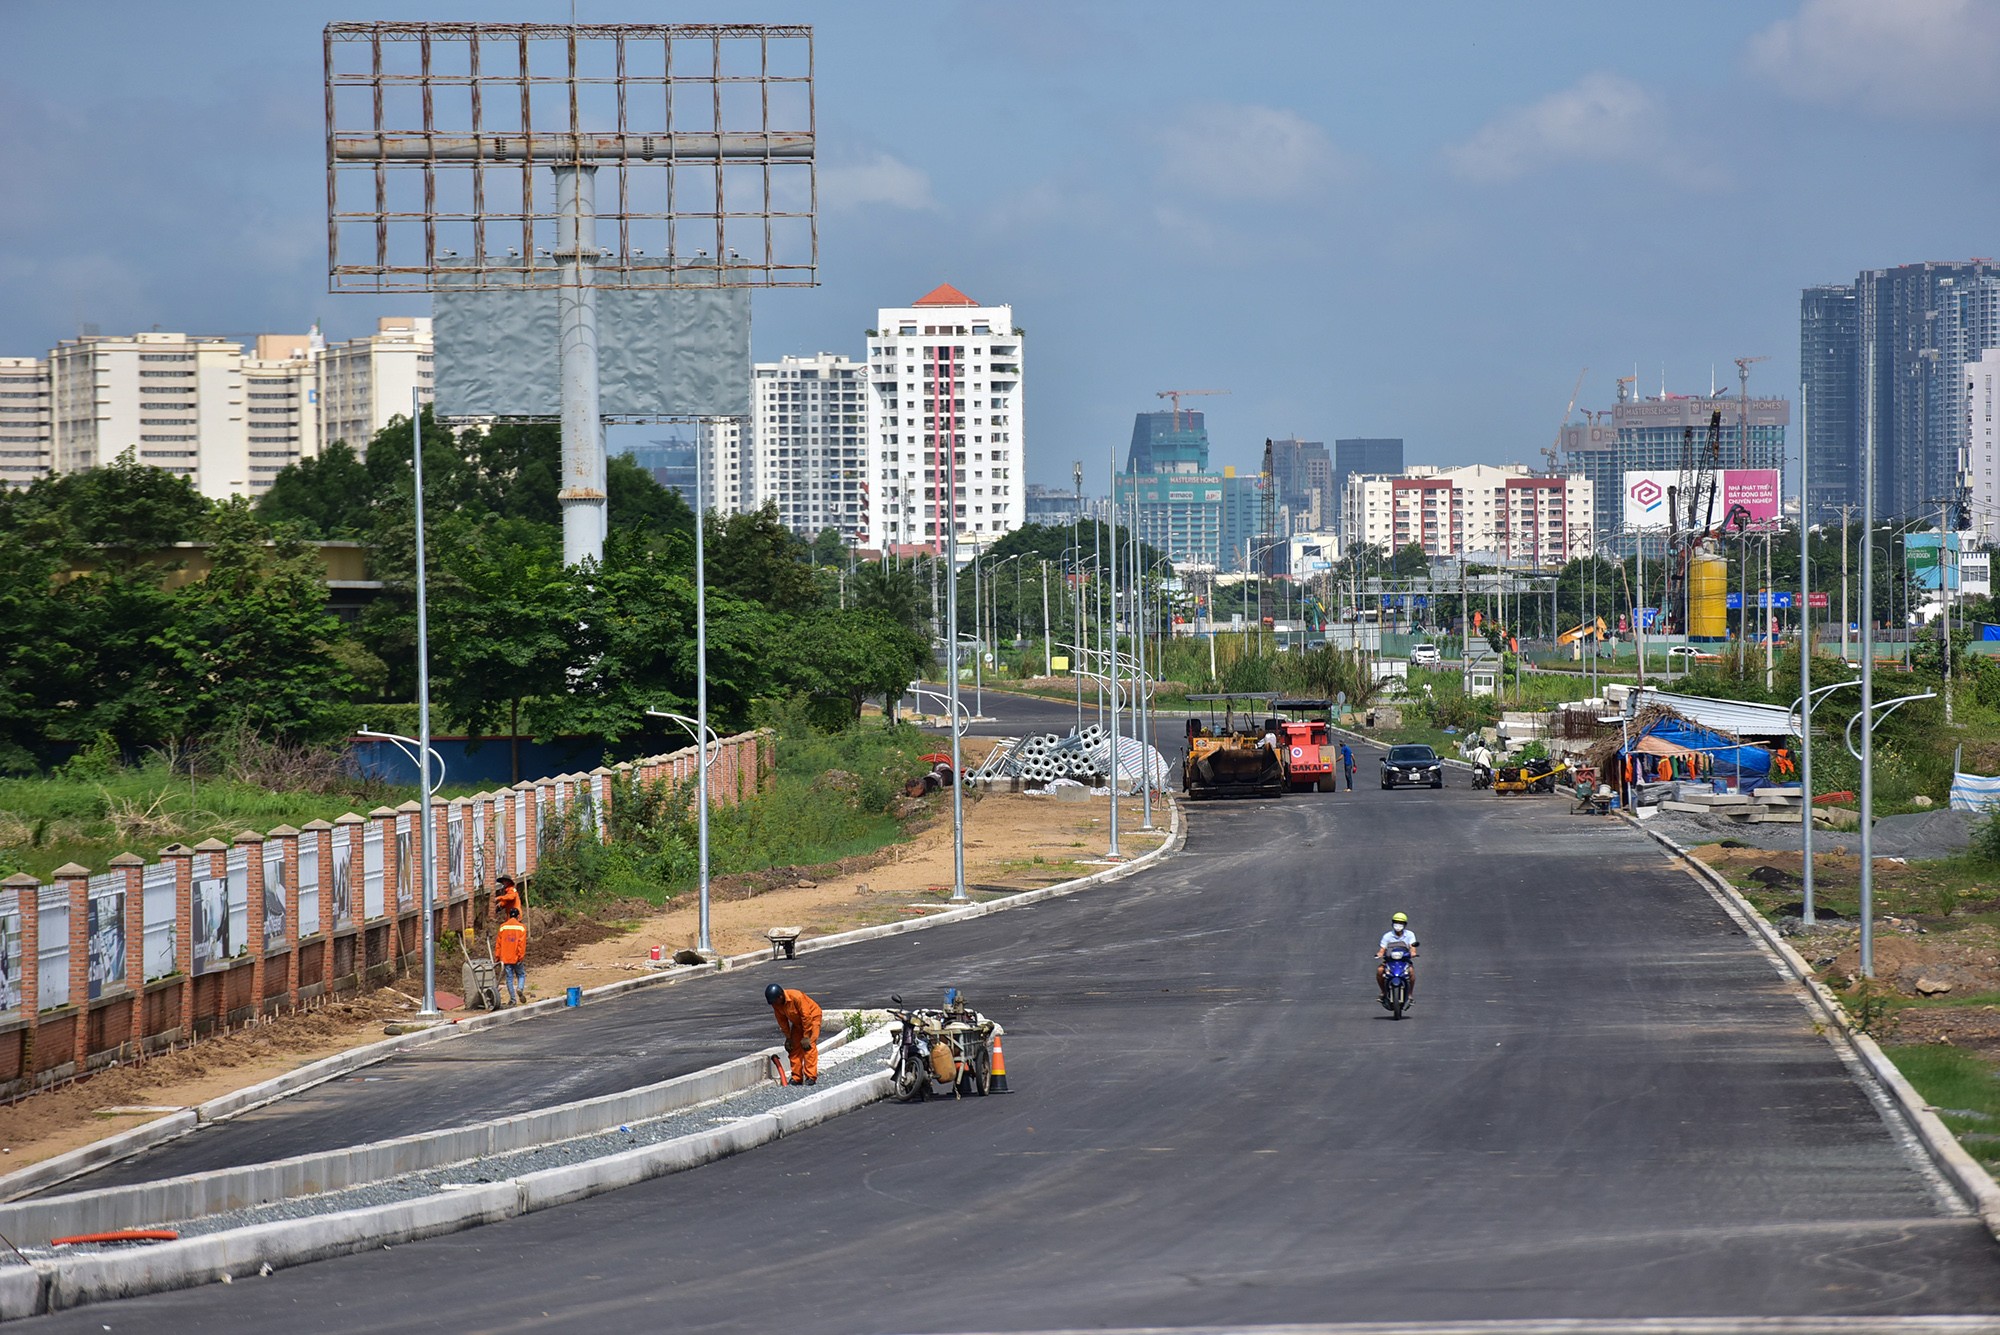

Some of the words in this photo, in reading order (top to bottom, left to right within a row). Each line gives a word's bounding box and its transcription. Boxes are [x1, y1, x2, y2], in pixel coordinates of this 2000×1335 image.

[1752, 401, 1781, 410] HOMES
[1626, 406, 1658, 415] MASTERISE
[1659, 405, 1680, 415] HOMES
[1170, 476, 1199, 484] MASTERISE
[1200, 476, 1219, 484] HOMES
[1291, 764, 1322, 772] SAKAI
